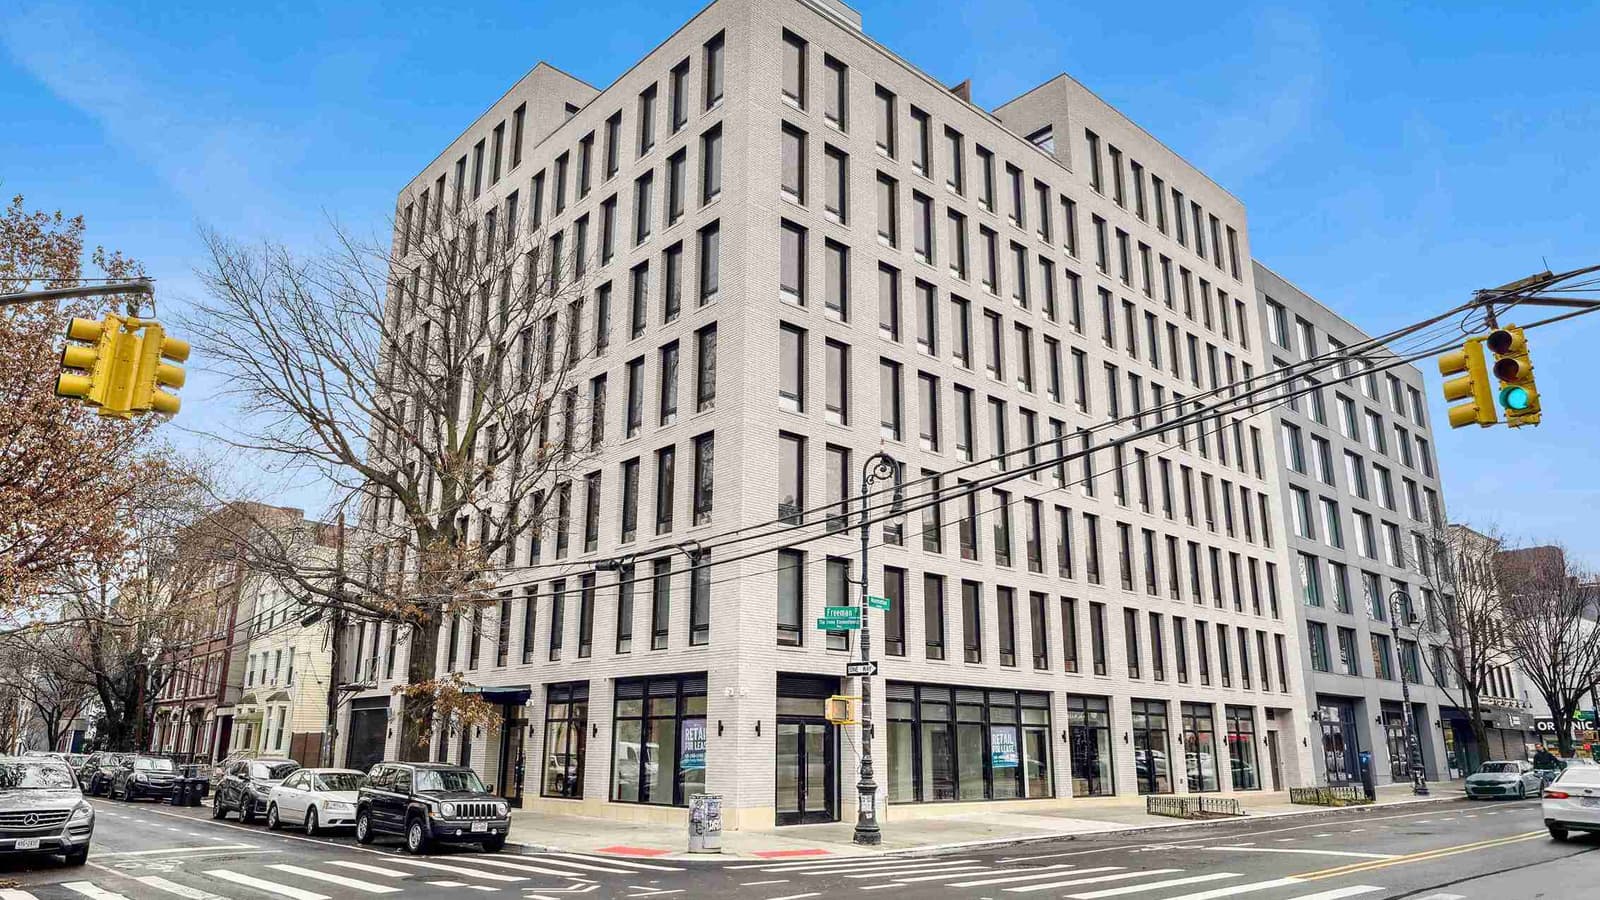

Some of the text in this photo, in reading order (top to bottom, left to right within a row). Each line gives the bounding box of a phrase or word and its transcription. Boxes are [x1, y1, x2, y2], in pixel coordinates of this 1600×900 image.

[826, 608, 853, 617] Freeman
[1537, 721, 1594, 731] ORNIC
[684, 727, 706, 741] RETAI
